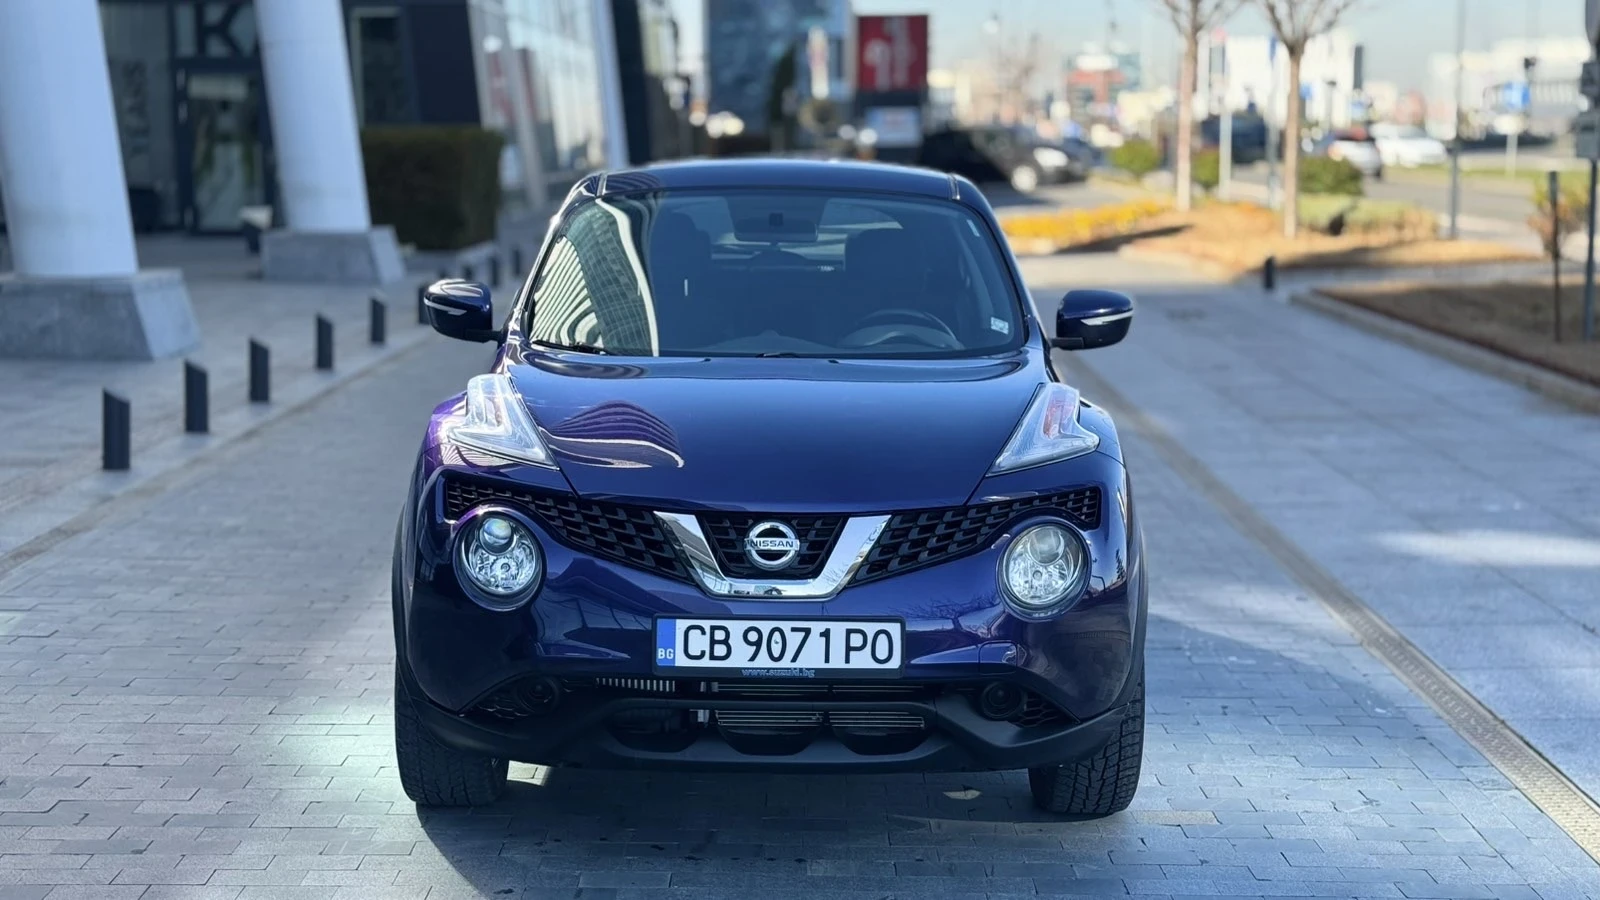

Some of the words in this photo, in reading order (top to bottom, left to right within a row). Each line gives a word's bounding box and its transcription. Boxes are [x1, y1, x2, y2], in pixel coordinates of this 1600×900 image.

[750, 540, 794, 548] NISSAN
[683, 624, 732, 661] CB
[742, 625, 831, 664] 9071
[845, 628, 894, 665] PO
[657, 647, 675, 660] BG
[741, 667, 816, 678] www.suzuki.bg
